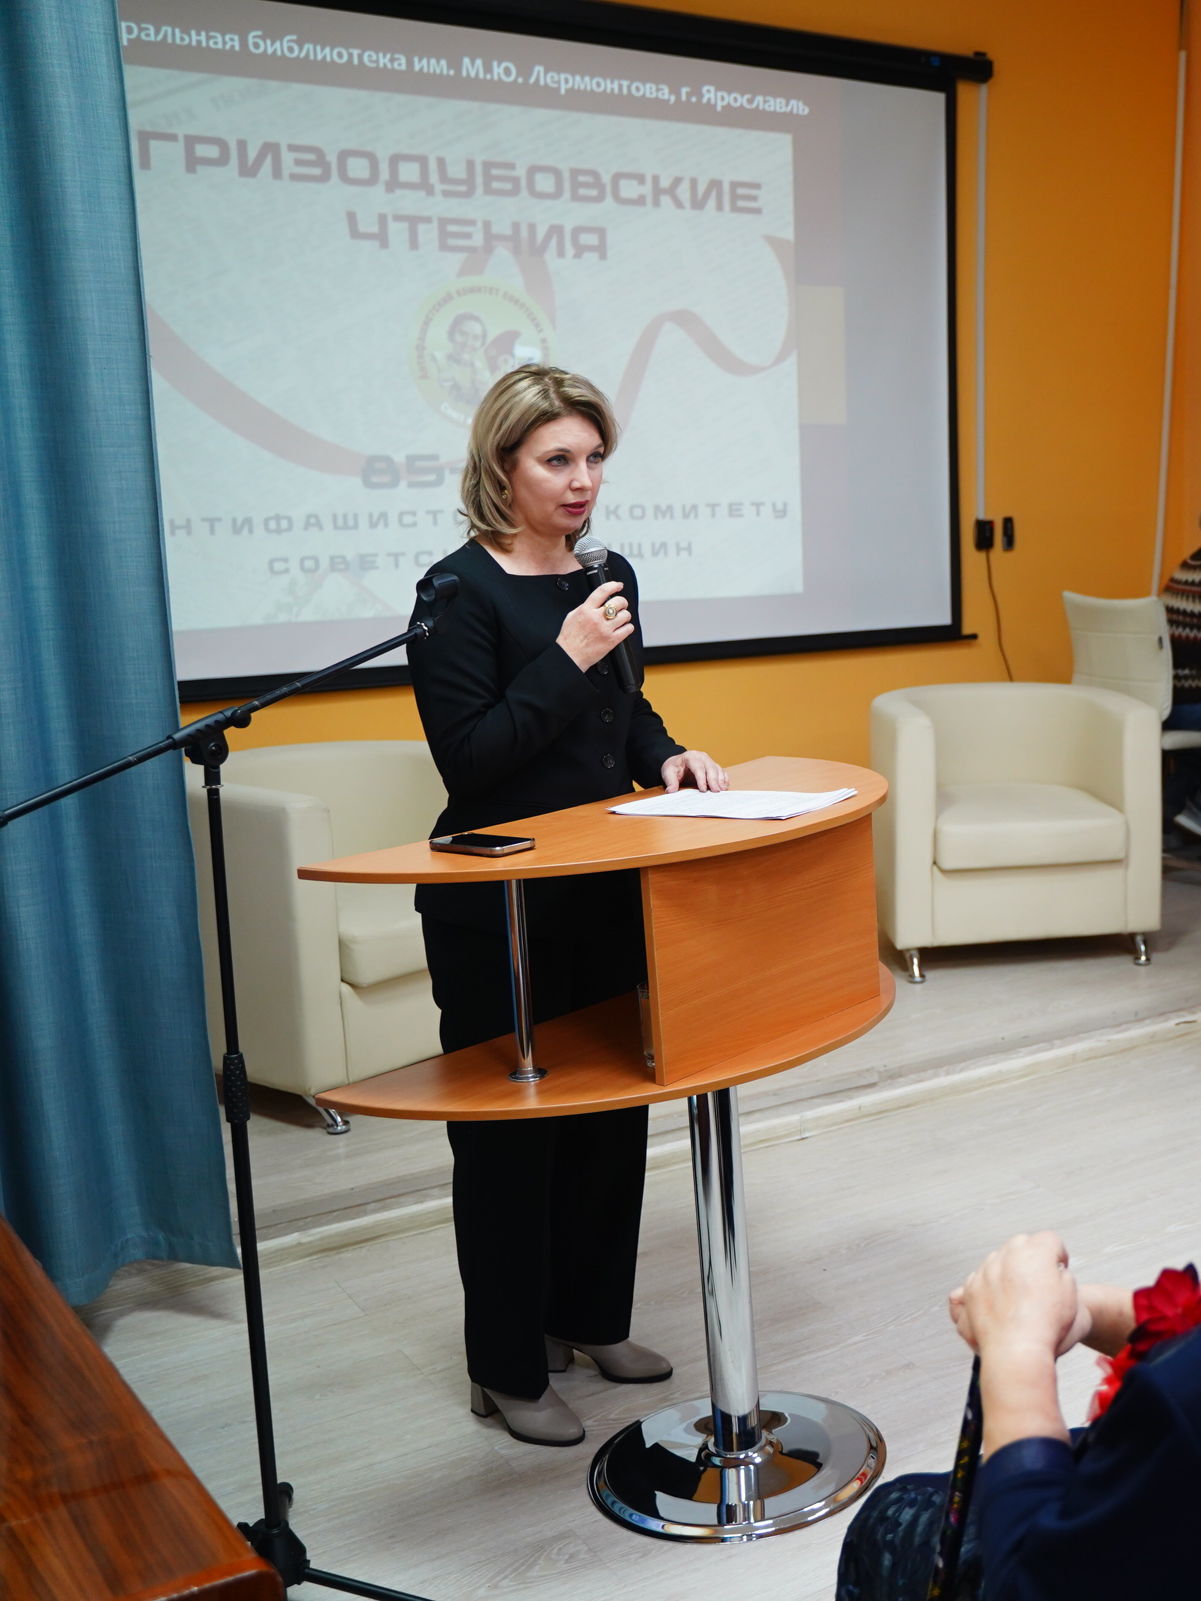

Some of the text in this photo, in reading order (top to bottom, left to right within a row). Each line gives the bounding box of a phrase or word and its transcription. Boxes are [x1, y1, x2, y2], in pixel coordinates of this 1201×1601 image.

[247, 30, 407, 71] библиотека
[413, 55, 455, 77] им.
[461, 56, 523, 84] М.Ю.
[529, 65, 676, 105] Лермонтова,
[680, 87, 697, 103] г.
[702, 85, 810, 116] Ярославль
[137, 129, 764, 217] ГРИЗОДУБОВСКИЕ
[345, 210, 609, 261] ЧТЕНИЯ
[605, 501, 789, 521] КОМИТЕТУ
[267, 549, 449, 576] СОВЕТС
[620, 540, 693, 560] ЩИН
